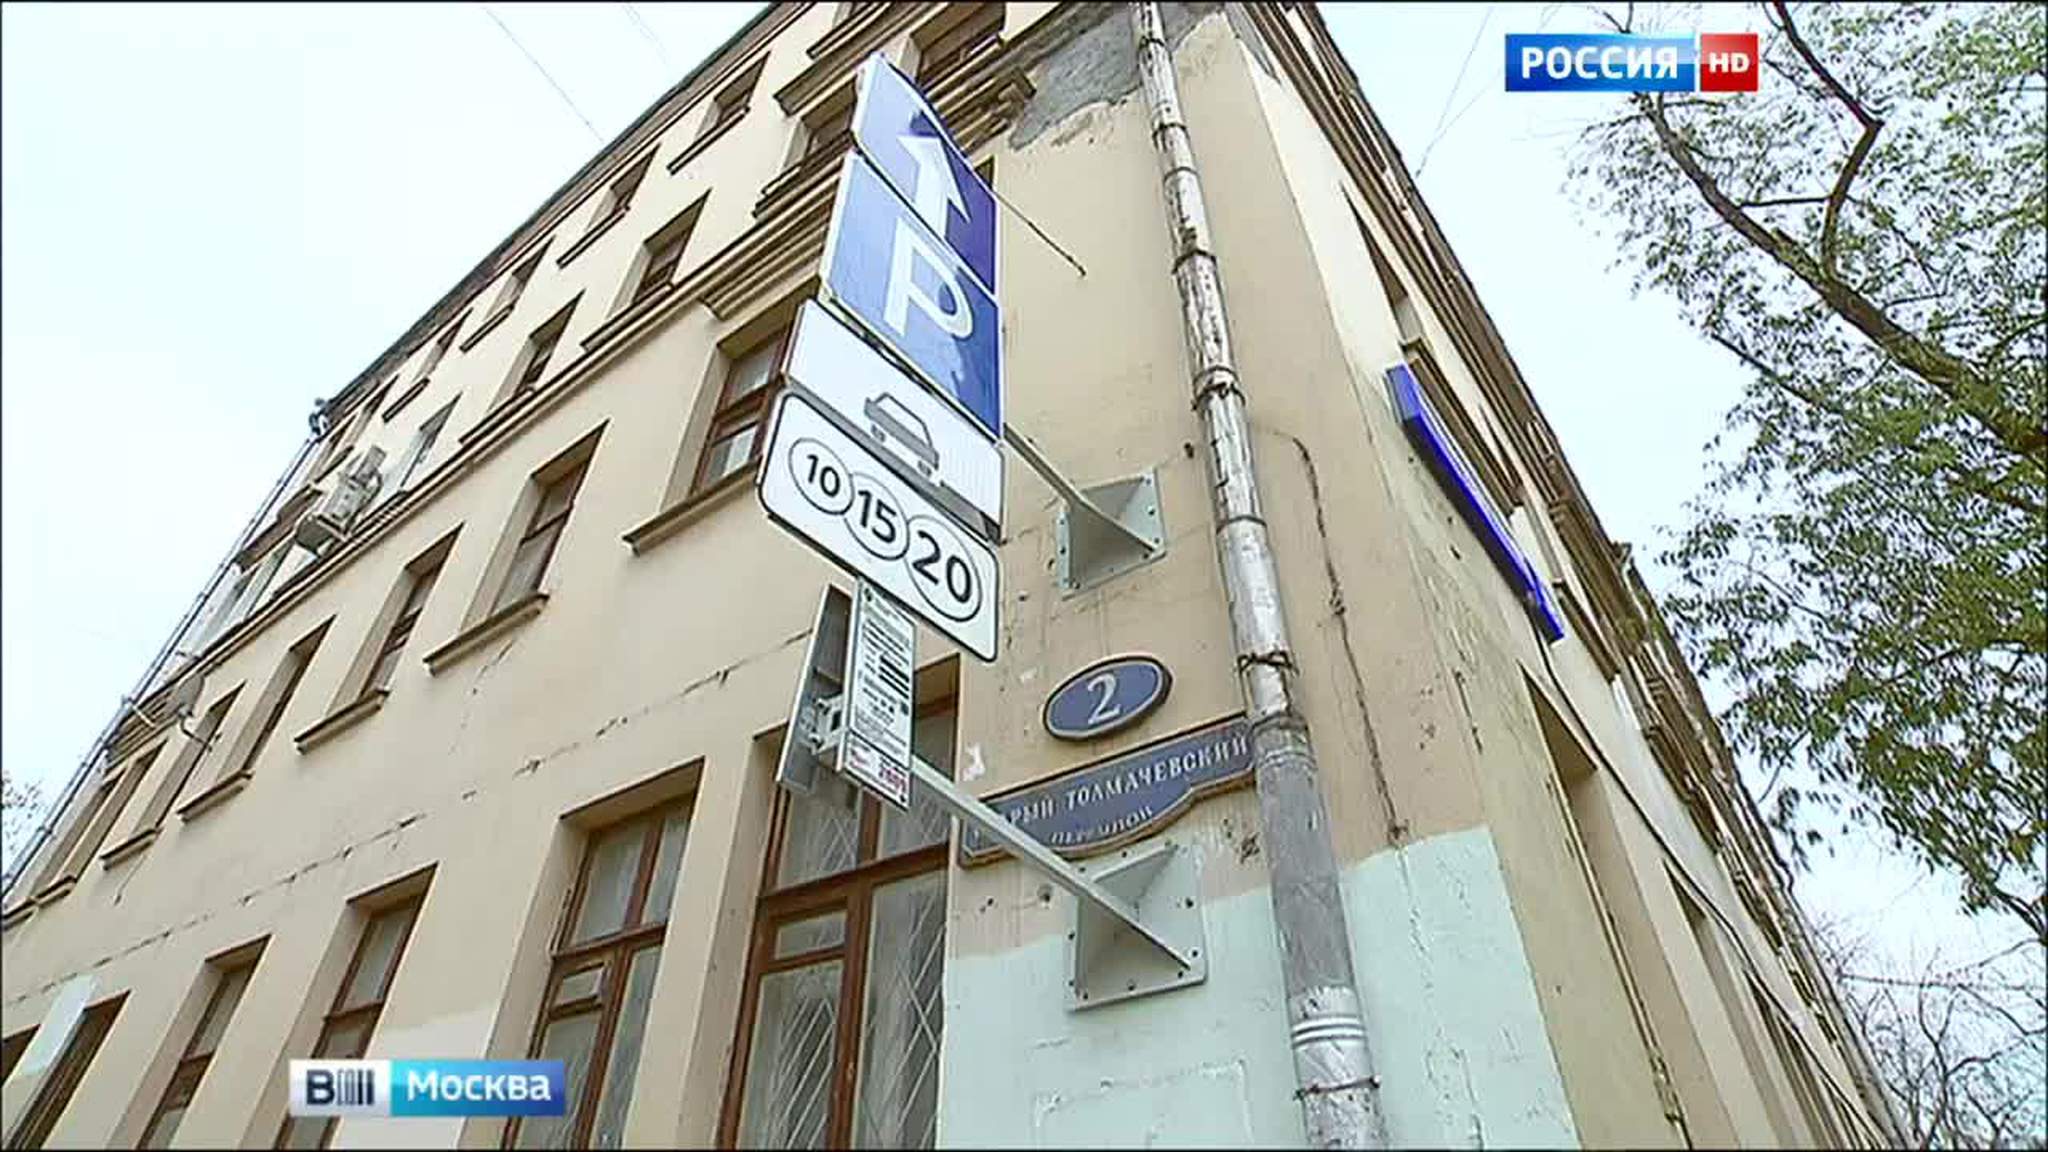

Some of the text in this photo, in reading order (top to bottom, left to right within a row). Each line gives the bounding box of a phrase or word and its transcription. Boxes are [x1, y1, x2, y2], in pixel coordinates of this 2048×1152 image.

[884, 214, 973, 339] P
[806, 453, 972, 603] 10 15 20
[1087, 672, 1122, 726] 2
[1066, 731, 1249, 811] ТОЛМАЧЕВСКИЙ
